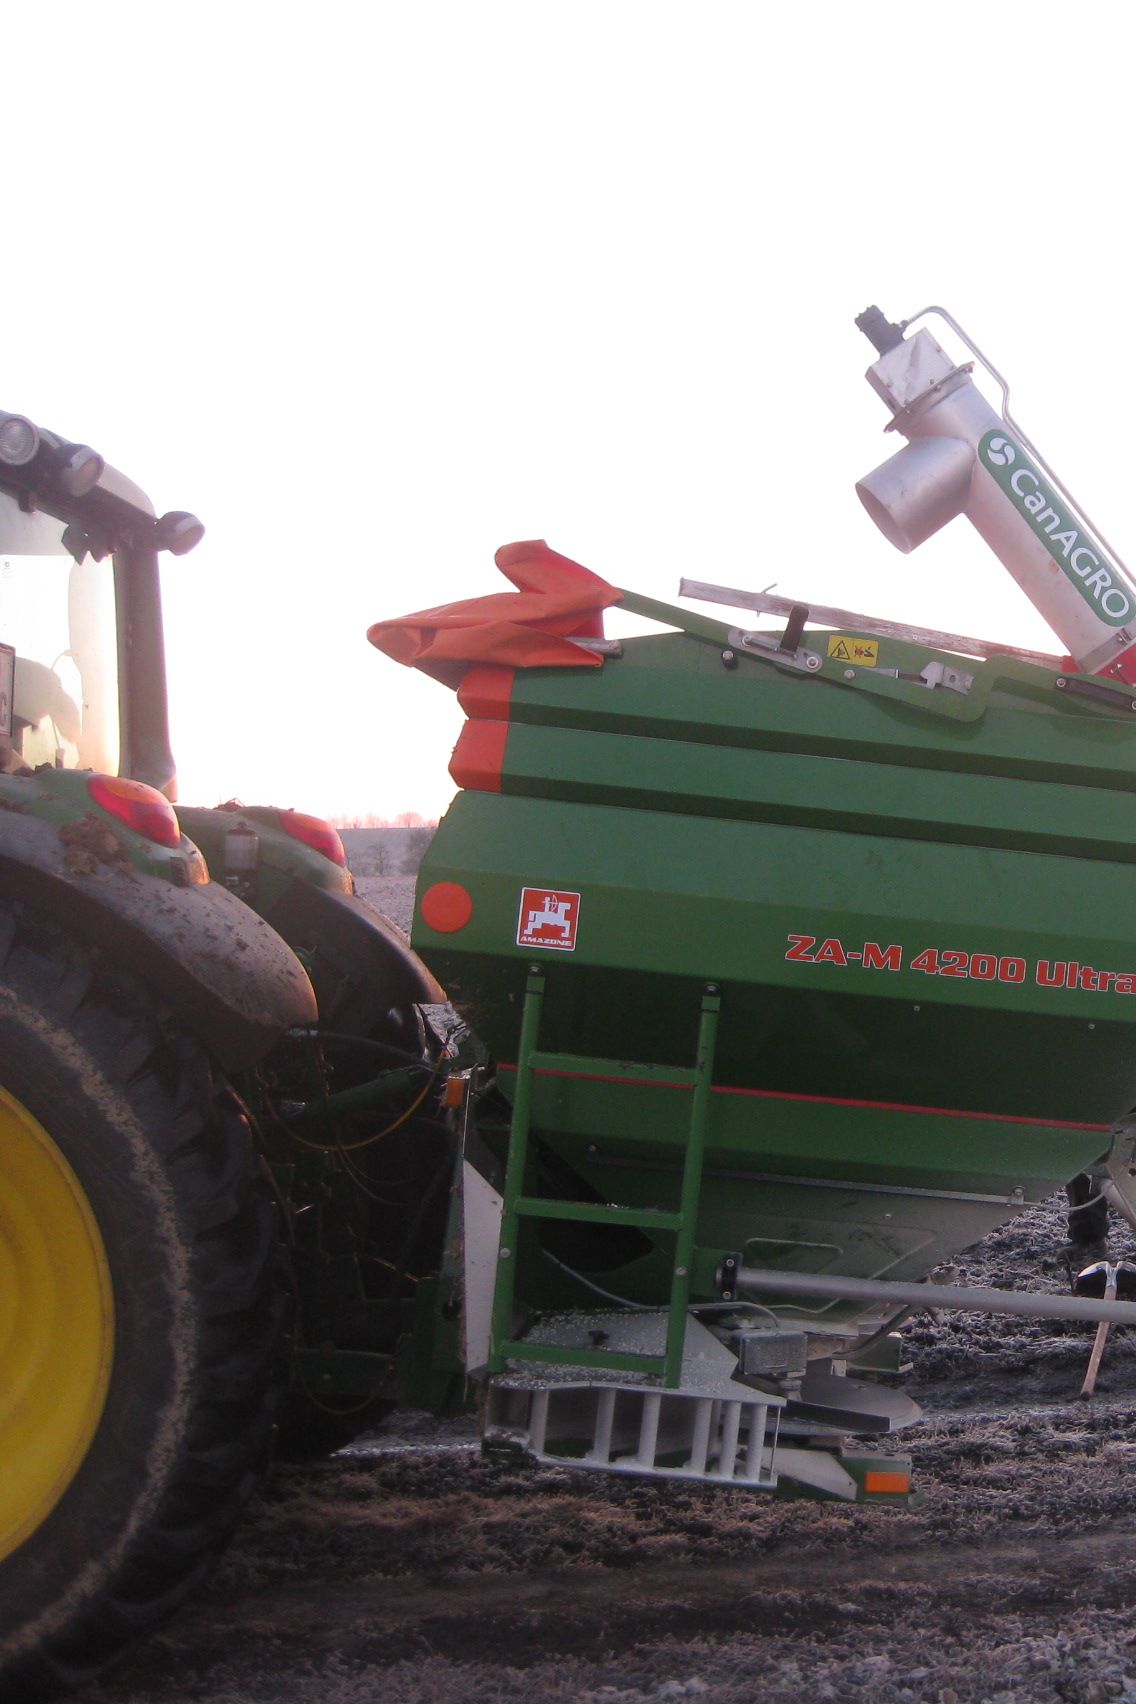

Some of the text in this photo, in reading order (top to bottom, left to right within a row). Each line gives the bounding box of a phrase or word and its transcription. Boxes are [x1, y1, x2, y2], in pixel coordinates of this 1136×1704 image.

[1011, 468, 1129, 618] CanAGRO
[520, 936, 572, 946] AMAZONE
[785, 934, 902, 971] ZA-M
[910, 948, 1026, 983] 4200
